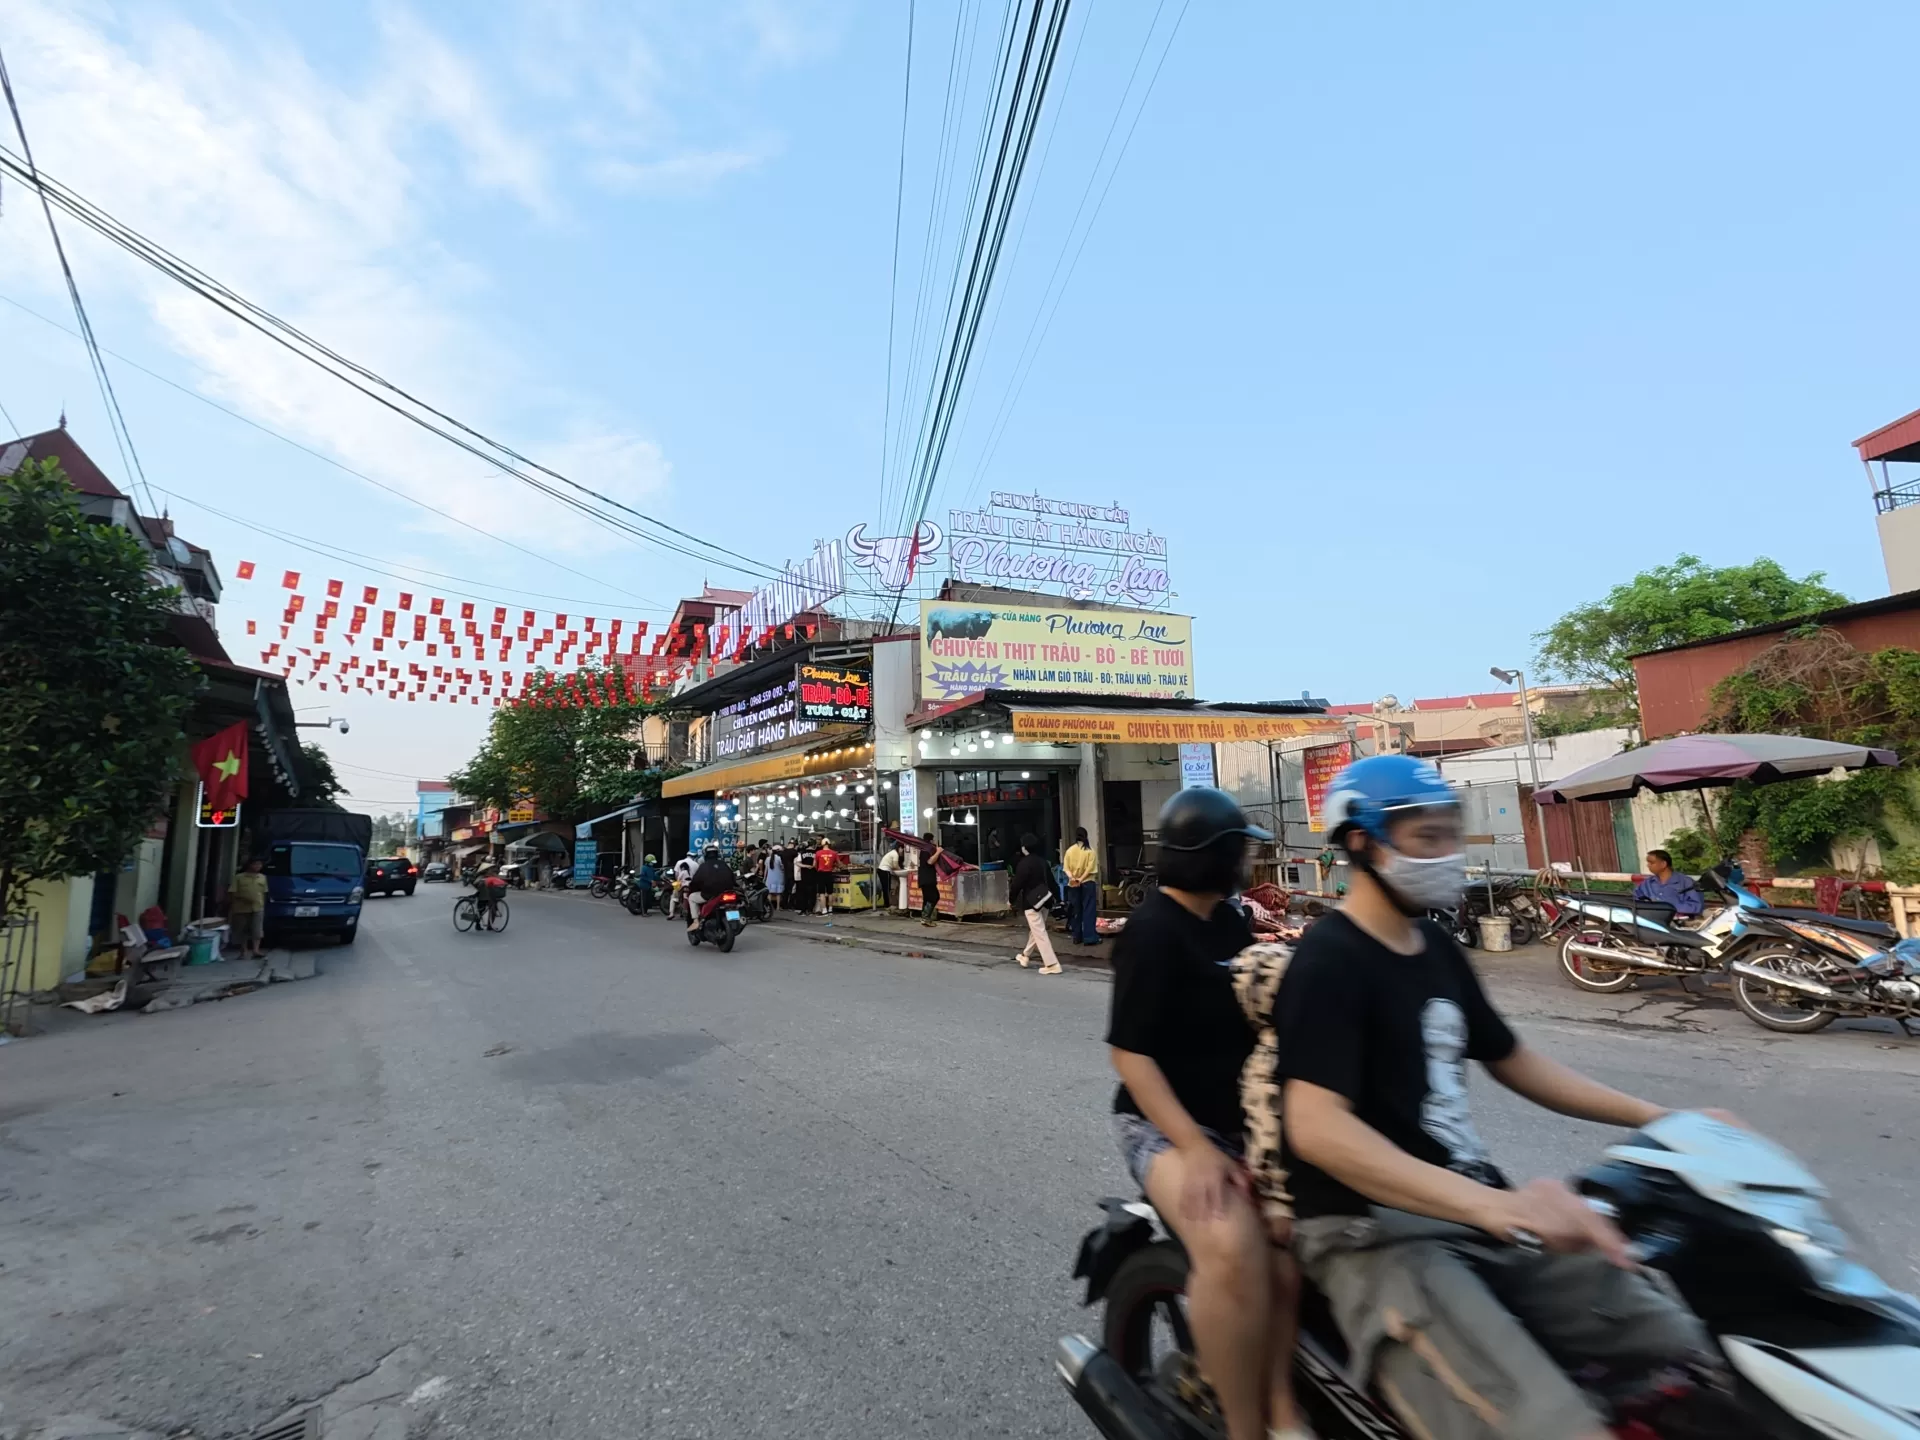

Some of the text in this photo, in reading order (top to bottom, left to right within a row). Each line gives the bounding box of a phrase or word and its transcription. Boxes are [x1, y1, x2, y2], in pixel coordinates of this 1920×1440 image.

[992, 491, 1130, 522] CHUYÊN CUNG CẤP
[951, 507, 1003, 534] TRÂU
[1060, 520, 1113, 549] HÀNG
[1122, 530, 1167, 555] NGÀY
[950, 537, 1171, 604] Phương Lan
[1002, 610, 1042, 623] CỬA HÀNG
[1045, 614, 1186, 645] Phương Lan
[932, 637, 998, 658] CHUYÊN
[1002, 642, 1036, 664] THỊT
[1041, 642, 1080, 662] TRÂU
[1096, 644, 1116, 664] BÒ
[1130, 646, 1148, 666] BÊ
[1153, 649, 1184, 666] TƯƠI
[802, 666, 841, 682] Phương
[938, 670, 998, 686] TRÂU GIẬT
[1012, 667, 1036, 684] NHẬN
[1038, 668, 1056, 682] LÀM
[1058, 668, 1071, 683] GIÒ
[1074, 669, 1093, 683] TRÂU
[1115, 670, 1134, 684] TRÂU
[1136, 672, 1152, 685] KHÔ
[1158, 672, 1177, 686] TRÂU
[788, 680, 796, 692] 09
[950, 684, 967, 692] HÀNG
[758, 706, 777, 722] CUNG
[778, 695, 794, 715] CẤP
[805, 704, 834, 716] TƯƠI
[840, 706, 868, 720] GIẬT
[1018, 714, 1115, 731] CỬA HÀNG PHƯƠNG LAN
[1128, 720, 1170, 738] CHUYÊN
[1172, 723, 1194, 742] THỊT
[1197, 720, 1224, 738] TRÂU
[1234, 720, 1248, 738] BÒ
[716, 734, 735, 757] TRÂU
[738, 728, 756, 753] GIẬT
[758, 722, 785, 746] HÀNG
